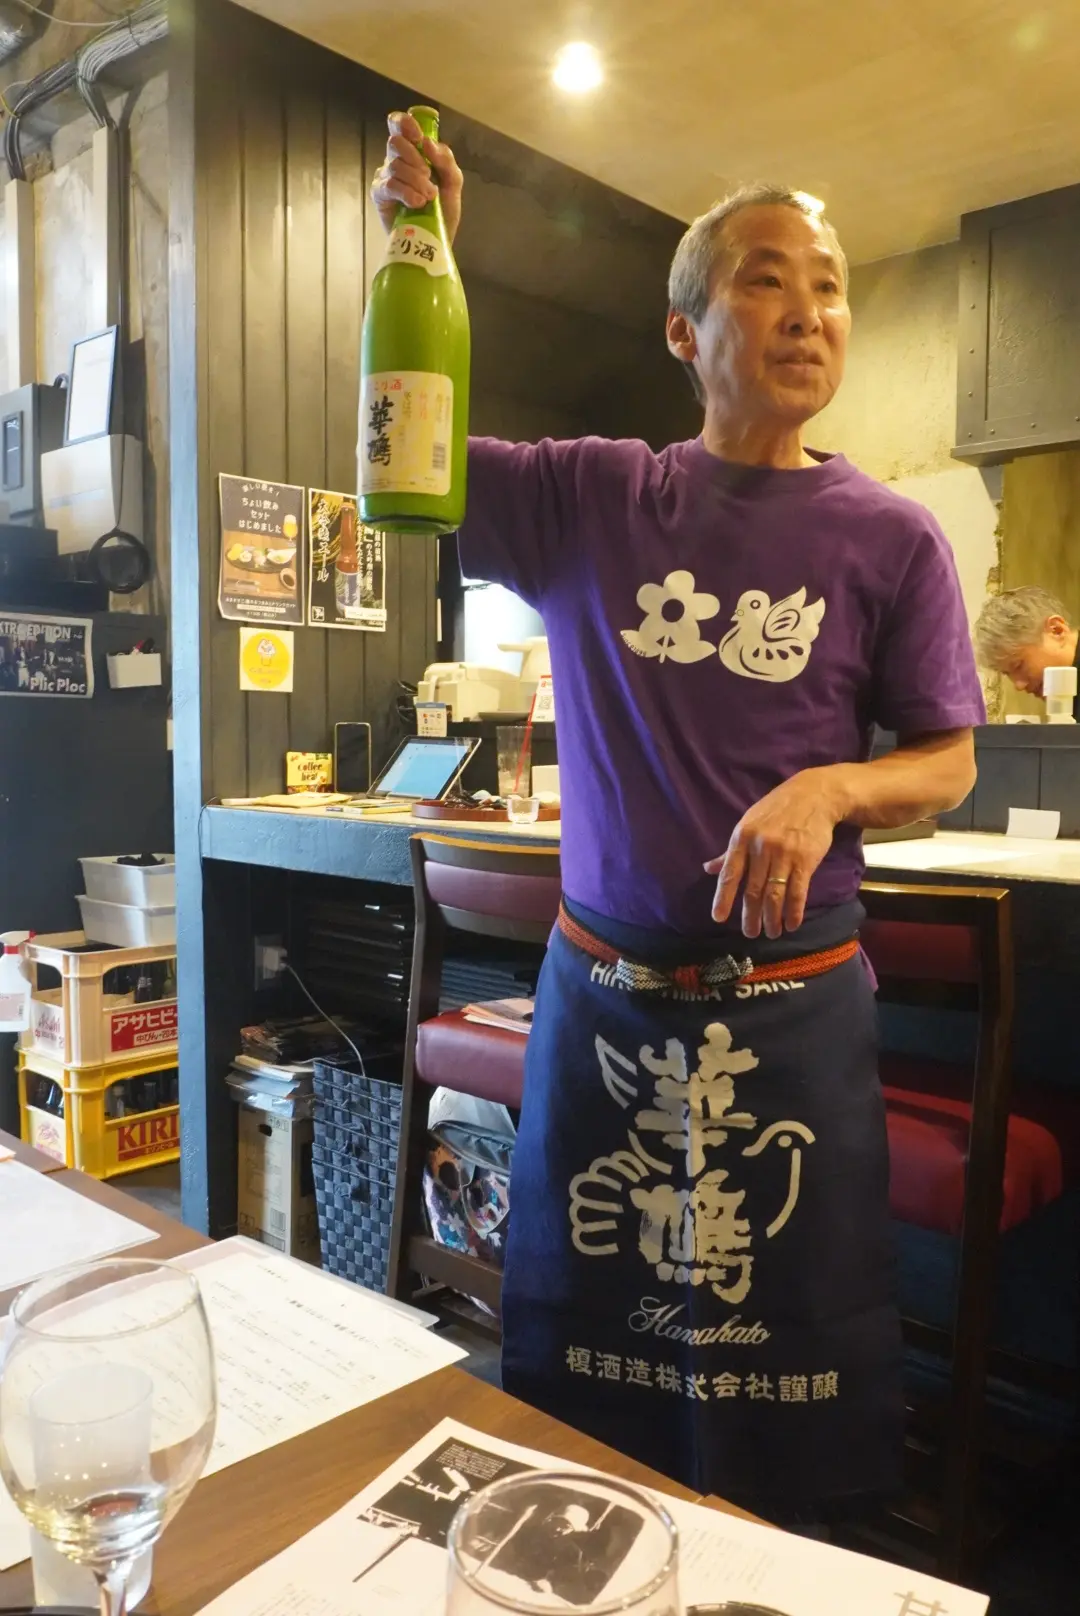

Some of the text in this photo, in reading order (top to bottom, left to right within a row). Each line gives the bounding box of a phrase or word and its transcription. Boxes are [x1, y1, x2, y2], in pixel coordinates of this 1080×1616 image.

[242, 497, 279, 511] ちょい飲み
[251, 509, 270, 520] セット
[238, 519, 282, 534] はじめました
[30, 677, 86, 693] Plic Ploc
[113, 1008, 178, 1034] アサヒビ
[628, 1295, 772, 1346] Hanahato
